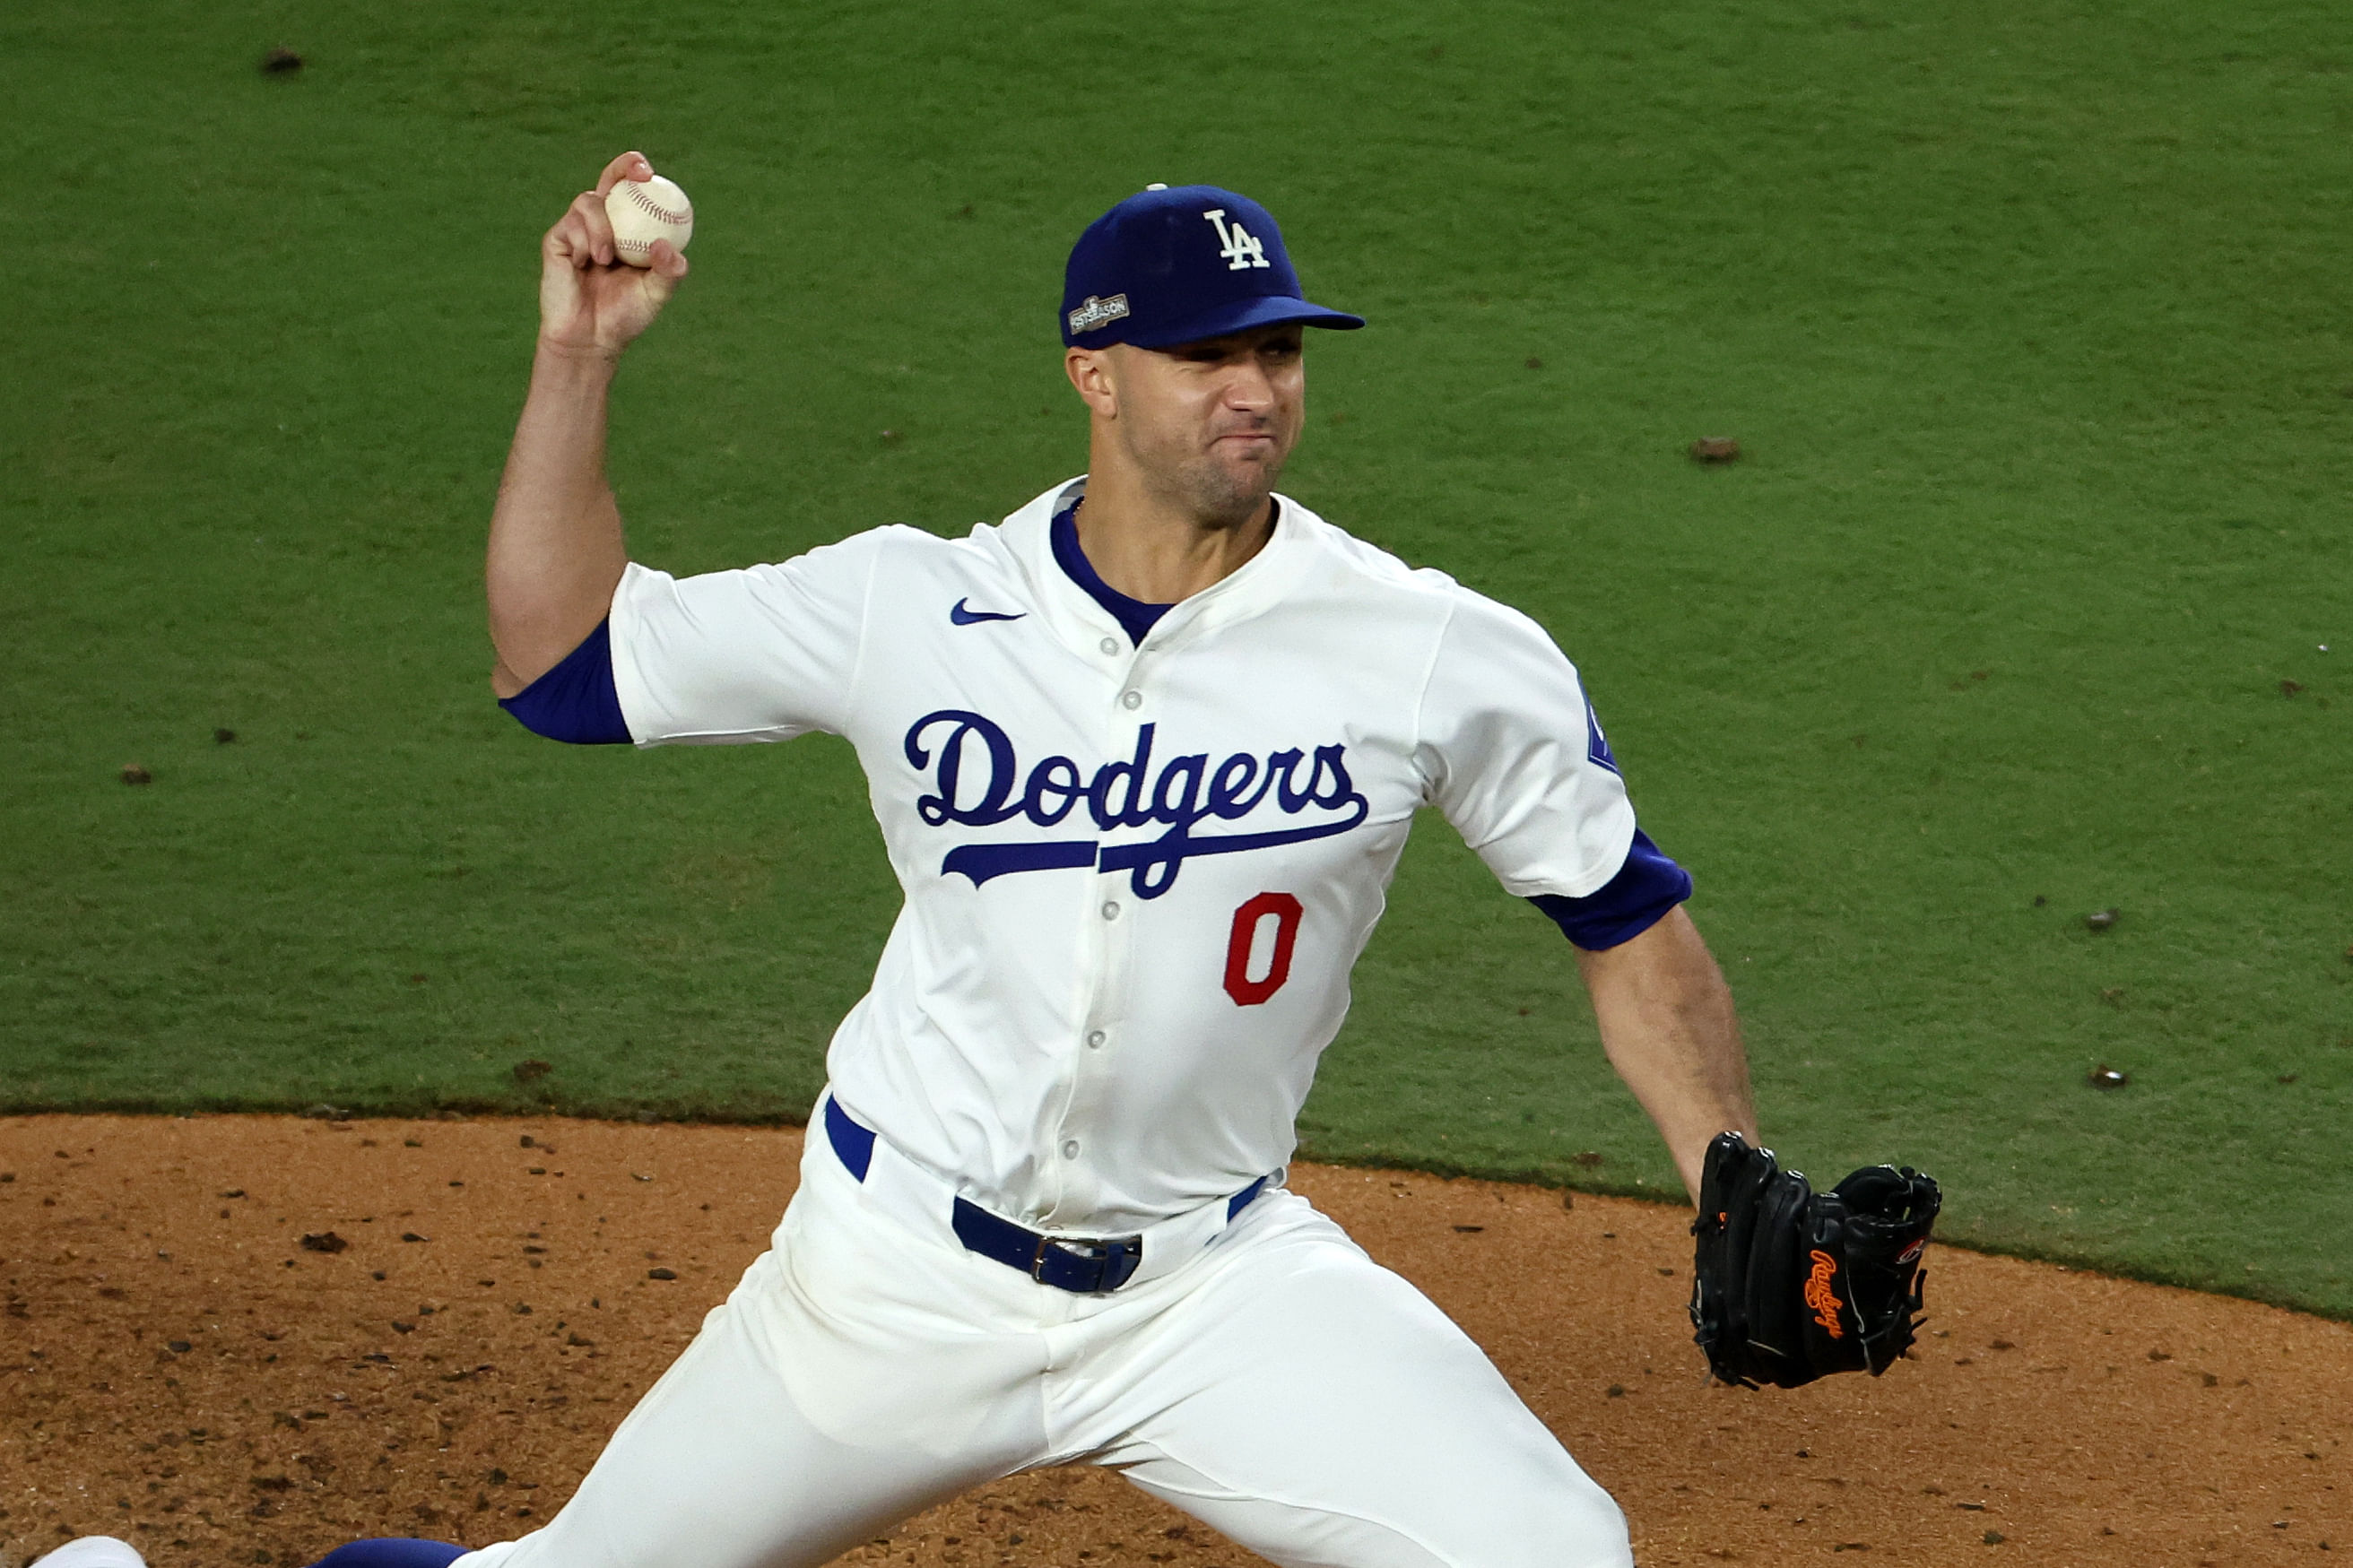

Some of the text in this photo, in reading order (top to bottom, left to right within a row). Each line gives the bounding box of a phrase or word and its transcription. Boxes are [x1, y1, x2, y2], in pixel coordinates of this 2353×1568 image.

[1203, 209, 1271, 271] LA
[904, 709, 1368, 899] Dodgers
[1223, 892, 1303, 1006] 0
[1805, 1249, 1844, 1338] Rawlings
